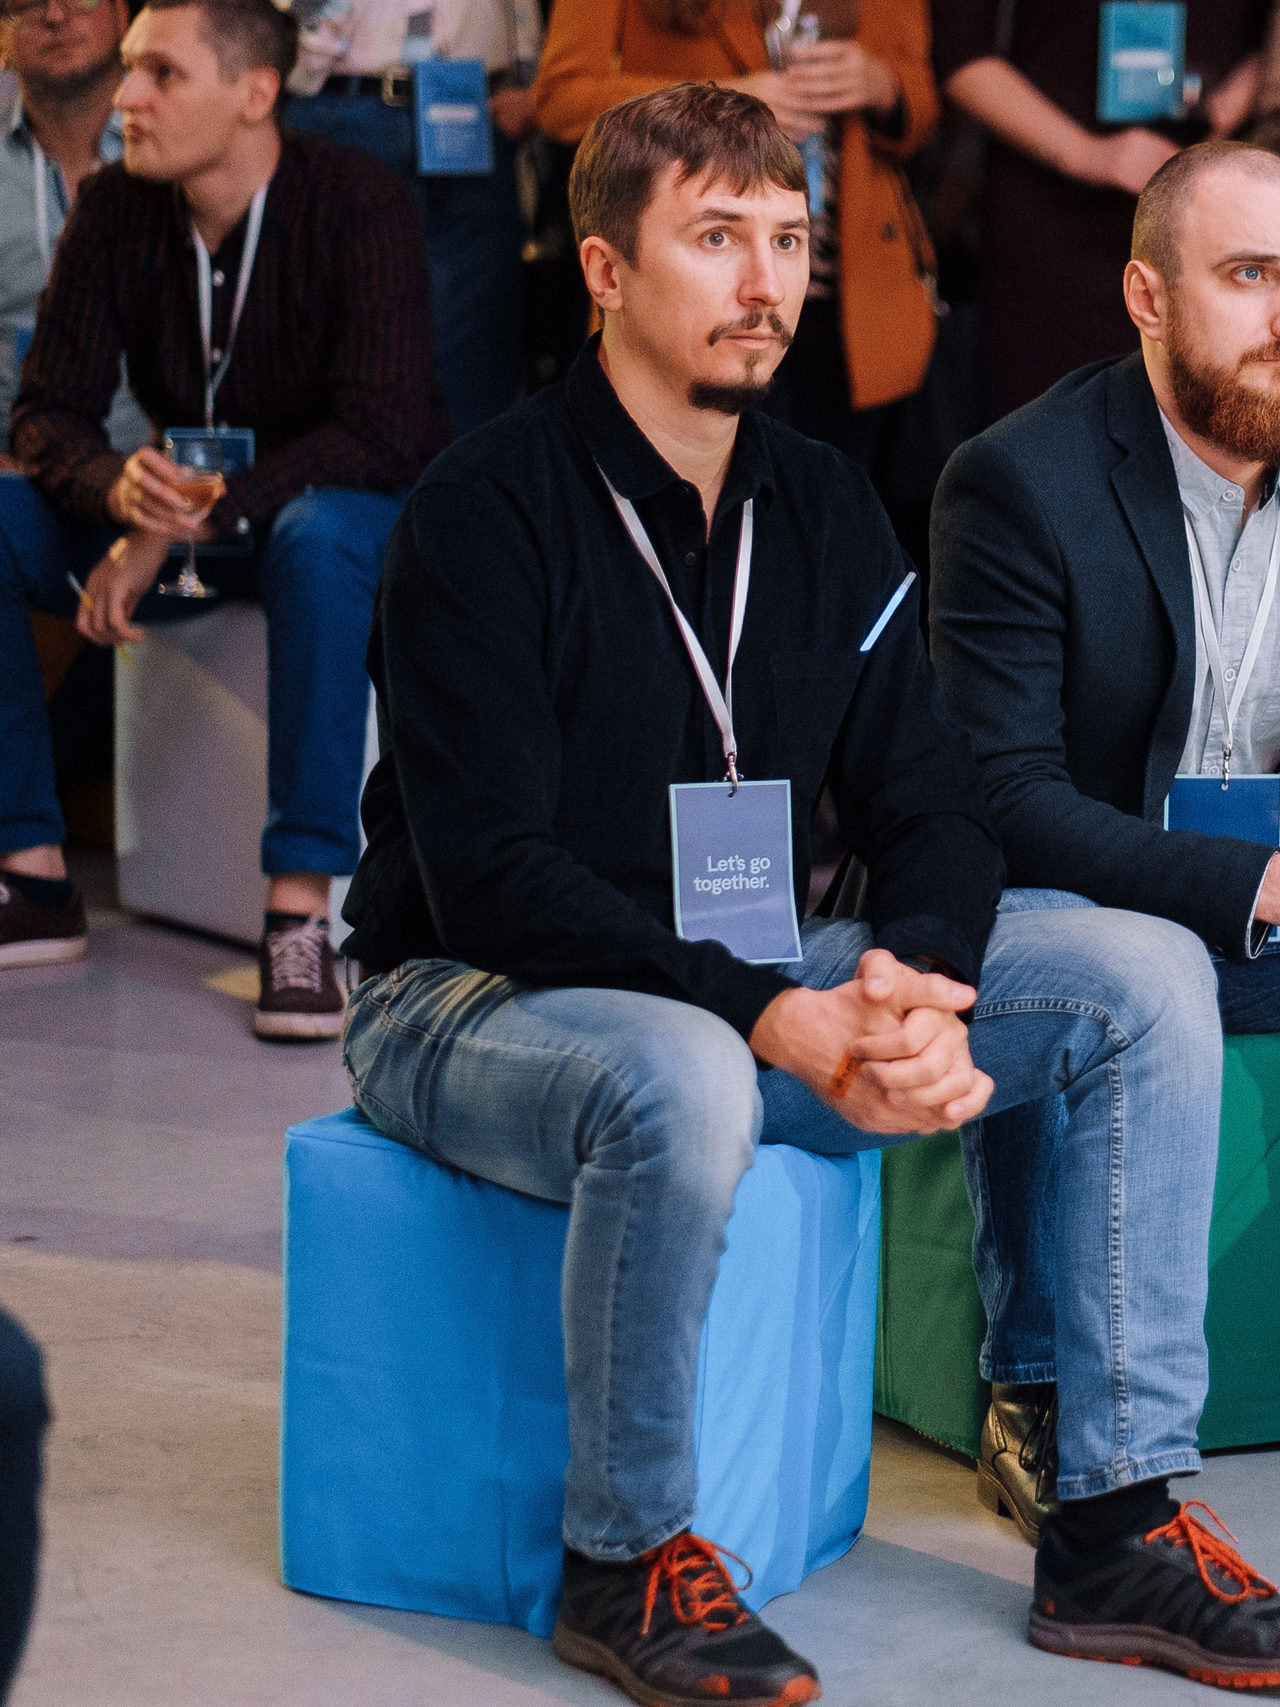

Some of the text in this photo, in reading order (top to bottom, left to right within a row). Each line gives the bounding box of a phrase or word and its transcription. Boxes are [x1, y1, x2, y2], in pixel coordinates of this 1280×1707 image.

[707, 855, 771, 874] Let's go
[693, 873, 770, 895] together.
